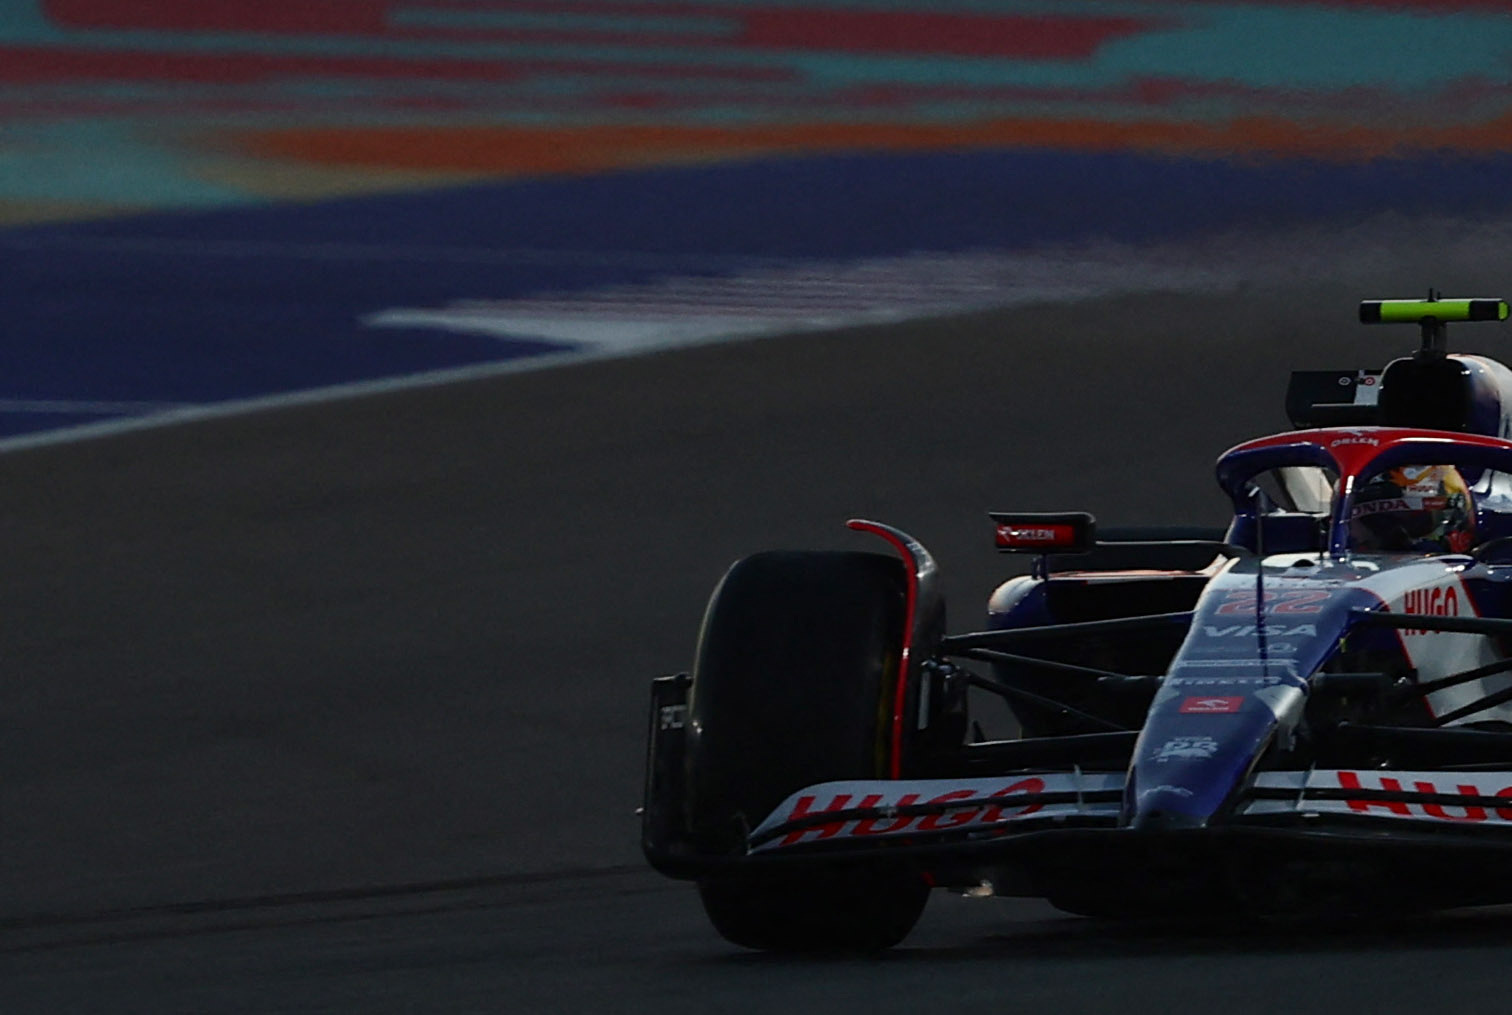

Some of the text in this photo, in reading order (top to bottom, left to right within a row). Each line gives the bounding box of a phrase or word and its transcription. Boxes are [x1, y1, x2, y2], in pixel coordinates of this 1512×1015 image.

[1204, 624, 1317, 637] VISA
[1403, 586, 1458, 636] HUGO
[781, 777, 1047, 846] HUGO
